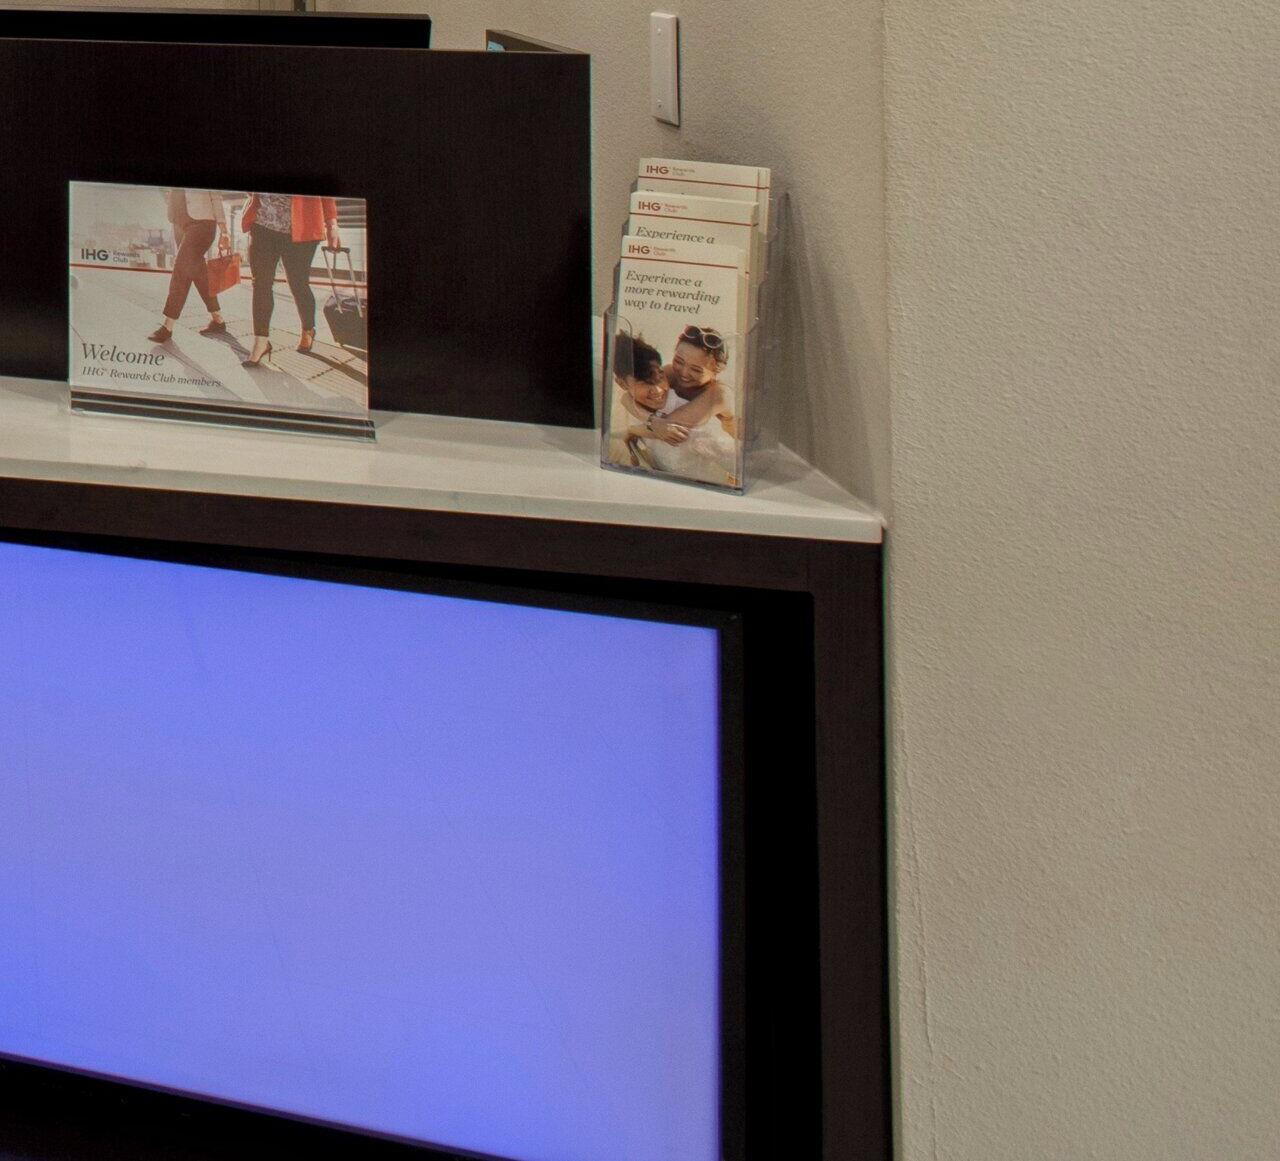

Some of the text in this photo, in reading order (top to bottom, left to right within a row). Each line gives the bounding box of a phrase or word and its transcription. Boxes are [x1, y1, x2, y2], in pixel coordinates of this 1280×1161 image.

[646, 165, 669, 174] IHG
[638, 201, 661, 211] IHG
[636, 226, 715, 244] Experience a
[81, 248, 109, 261] IHG
[628, 244, 650, 254] IHG
[625, 270, 692, 286] Experience
[625, 286, 720, 305] more rewarding
[624, 299, 700, 314] way to travel
[82, 342, 165, 366] Welcome
[110, 368, 151, 381] Rewards
[152, 373, 176, 383] Club
[177, 376, 222, 388] members
